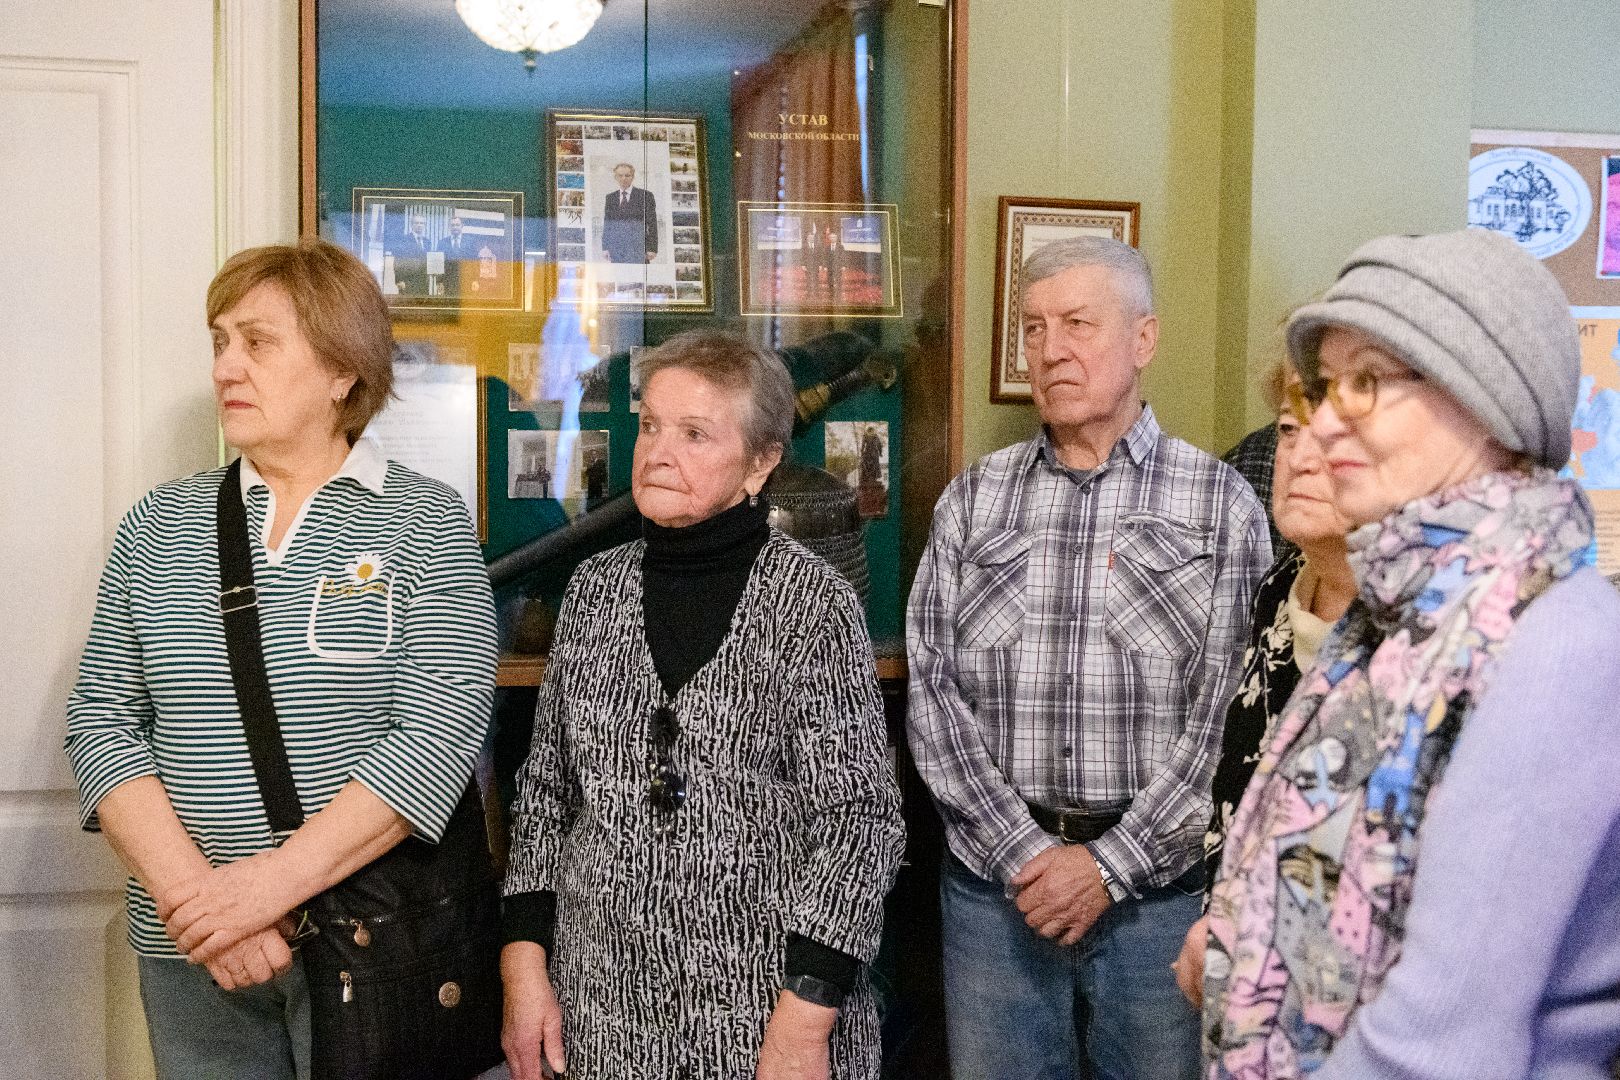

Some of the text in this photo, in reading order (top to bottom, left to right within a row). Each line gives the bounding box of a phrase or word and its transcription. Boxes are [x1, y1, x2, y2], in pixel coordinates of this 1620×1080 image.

[778, 113, 829, 126] УСТАВ
[749, 131, 859, 141] МОСКОВСКОЙ ОБЛАСТИ
